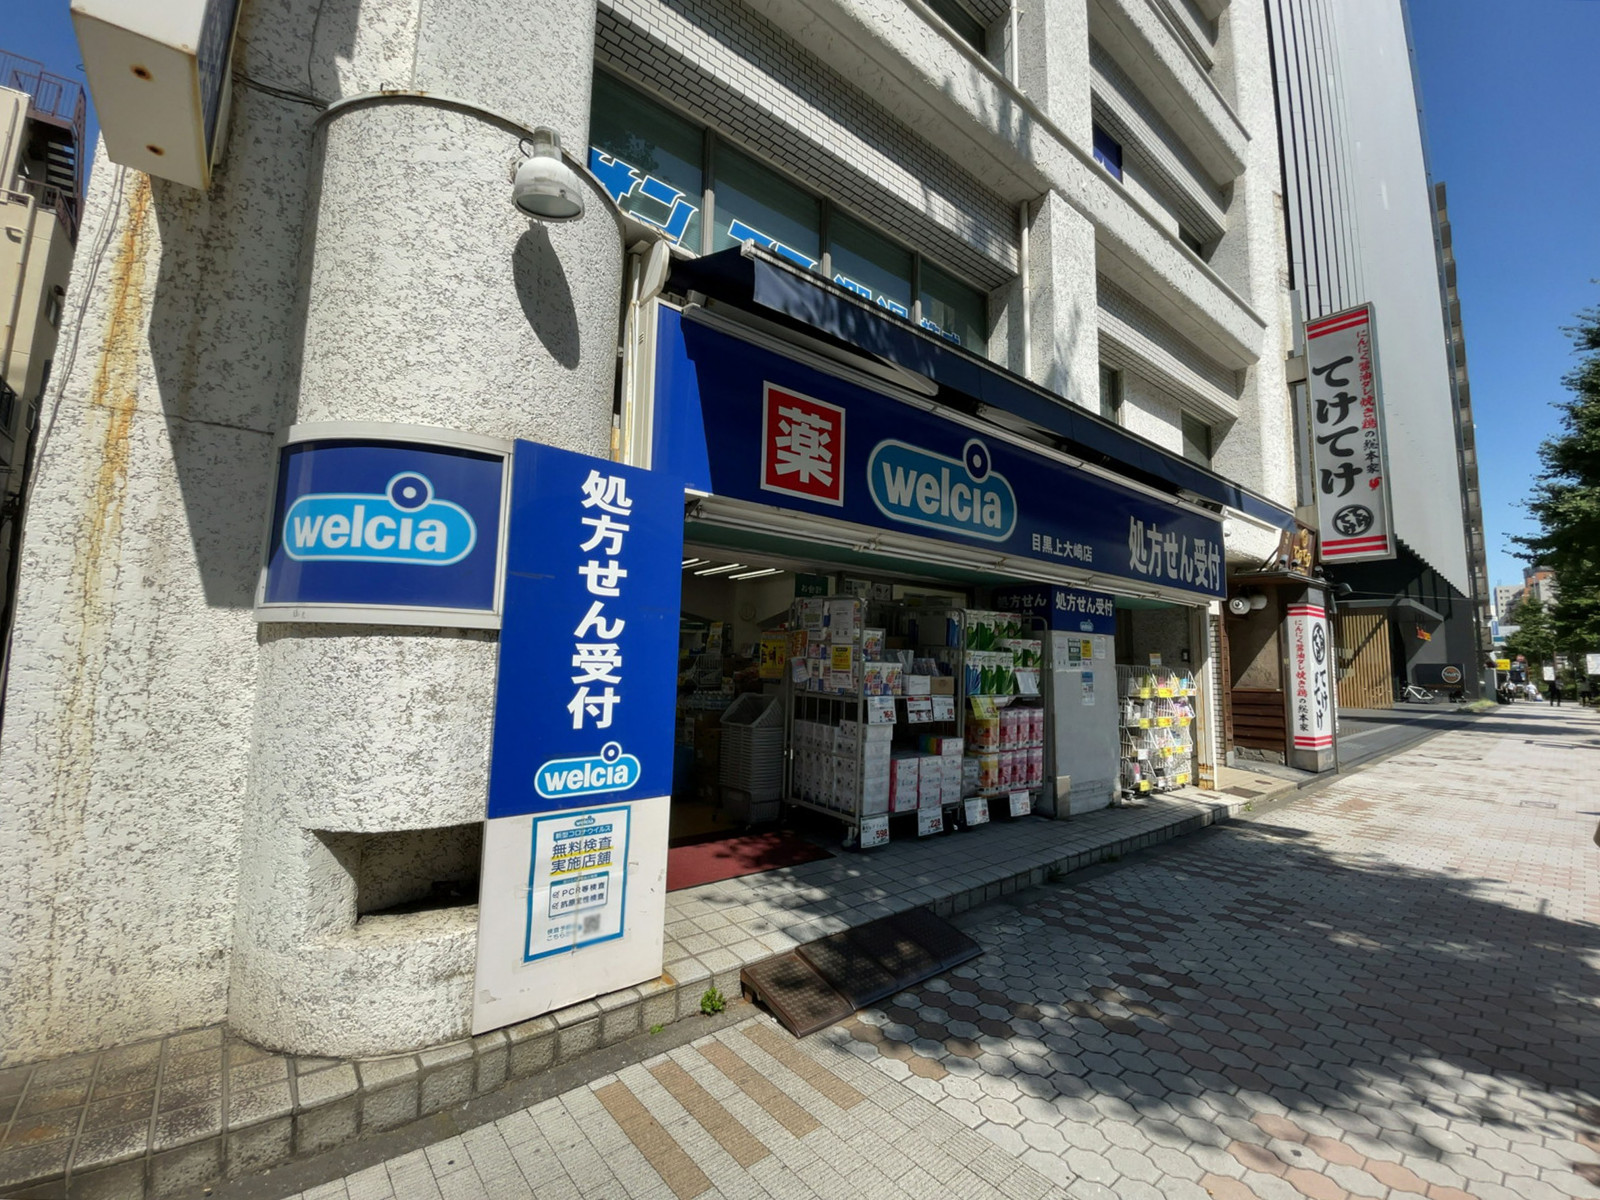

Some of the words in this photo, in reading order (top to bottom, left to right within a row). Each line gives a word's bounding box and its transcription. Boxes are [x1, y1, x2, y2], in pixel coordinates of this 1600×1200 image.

[774, 404, 833, 488] 薬
[1312, 355, 1363, 498] てけてけ
[881, 460, 1002, 530] welcia
[293, 502, 448, 555] welcia
[1031, 532, 1093, 563] 目黒上大崎店
[1128, 515, 1222, 591] 処方せん受付
[566, 468, 633, 730] 処方せん受付
[1055, 591, 1114, 617] 処方せん受付
[543, 760, 630, 792] welcia
[551, 836, 612, 858] 無料検査
[551, 851, 612, 874] 実施店舗
